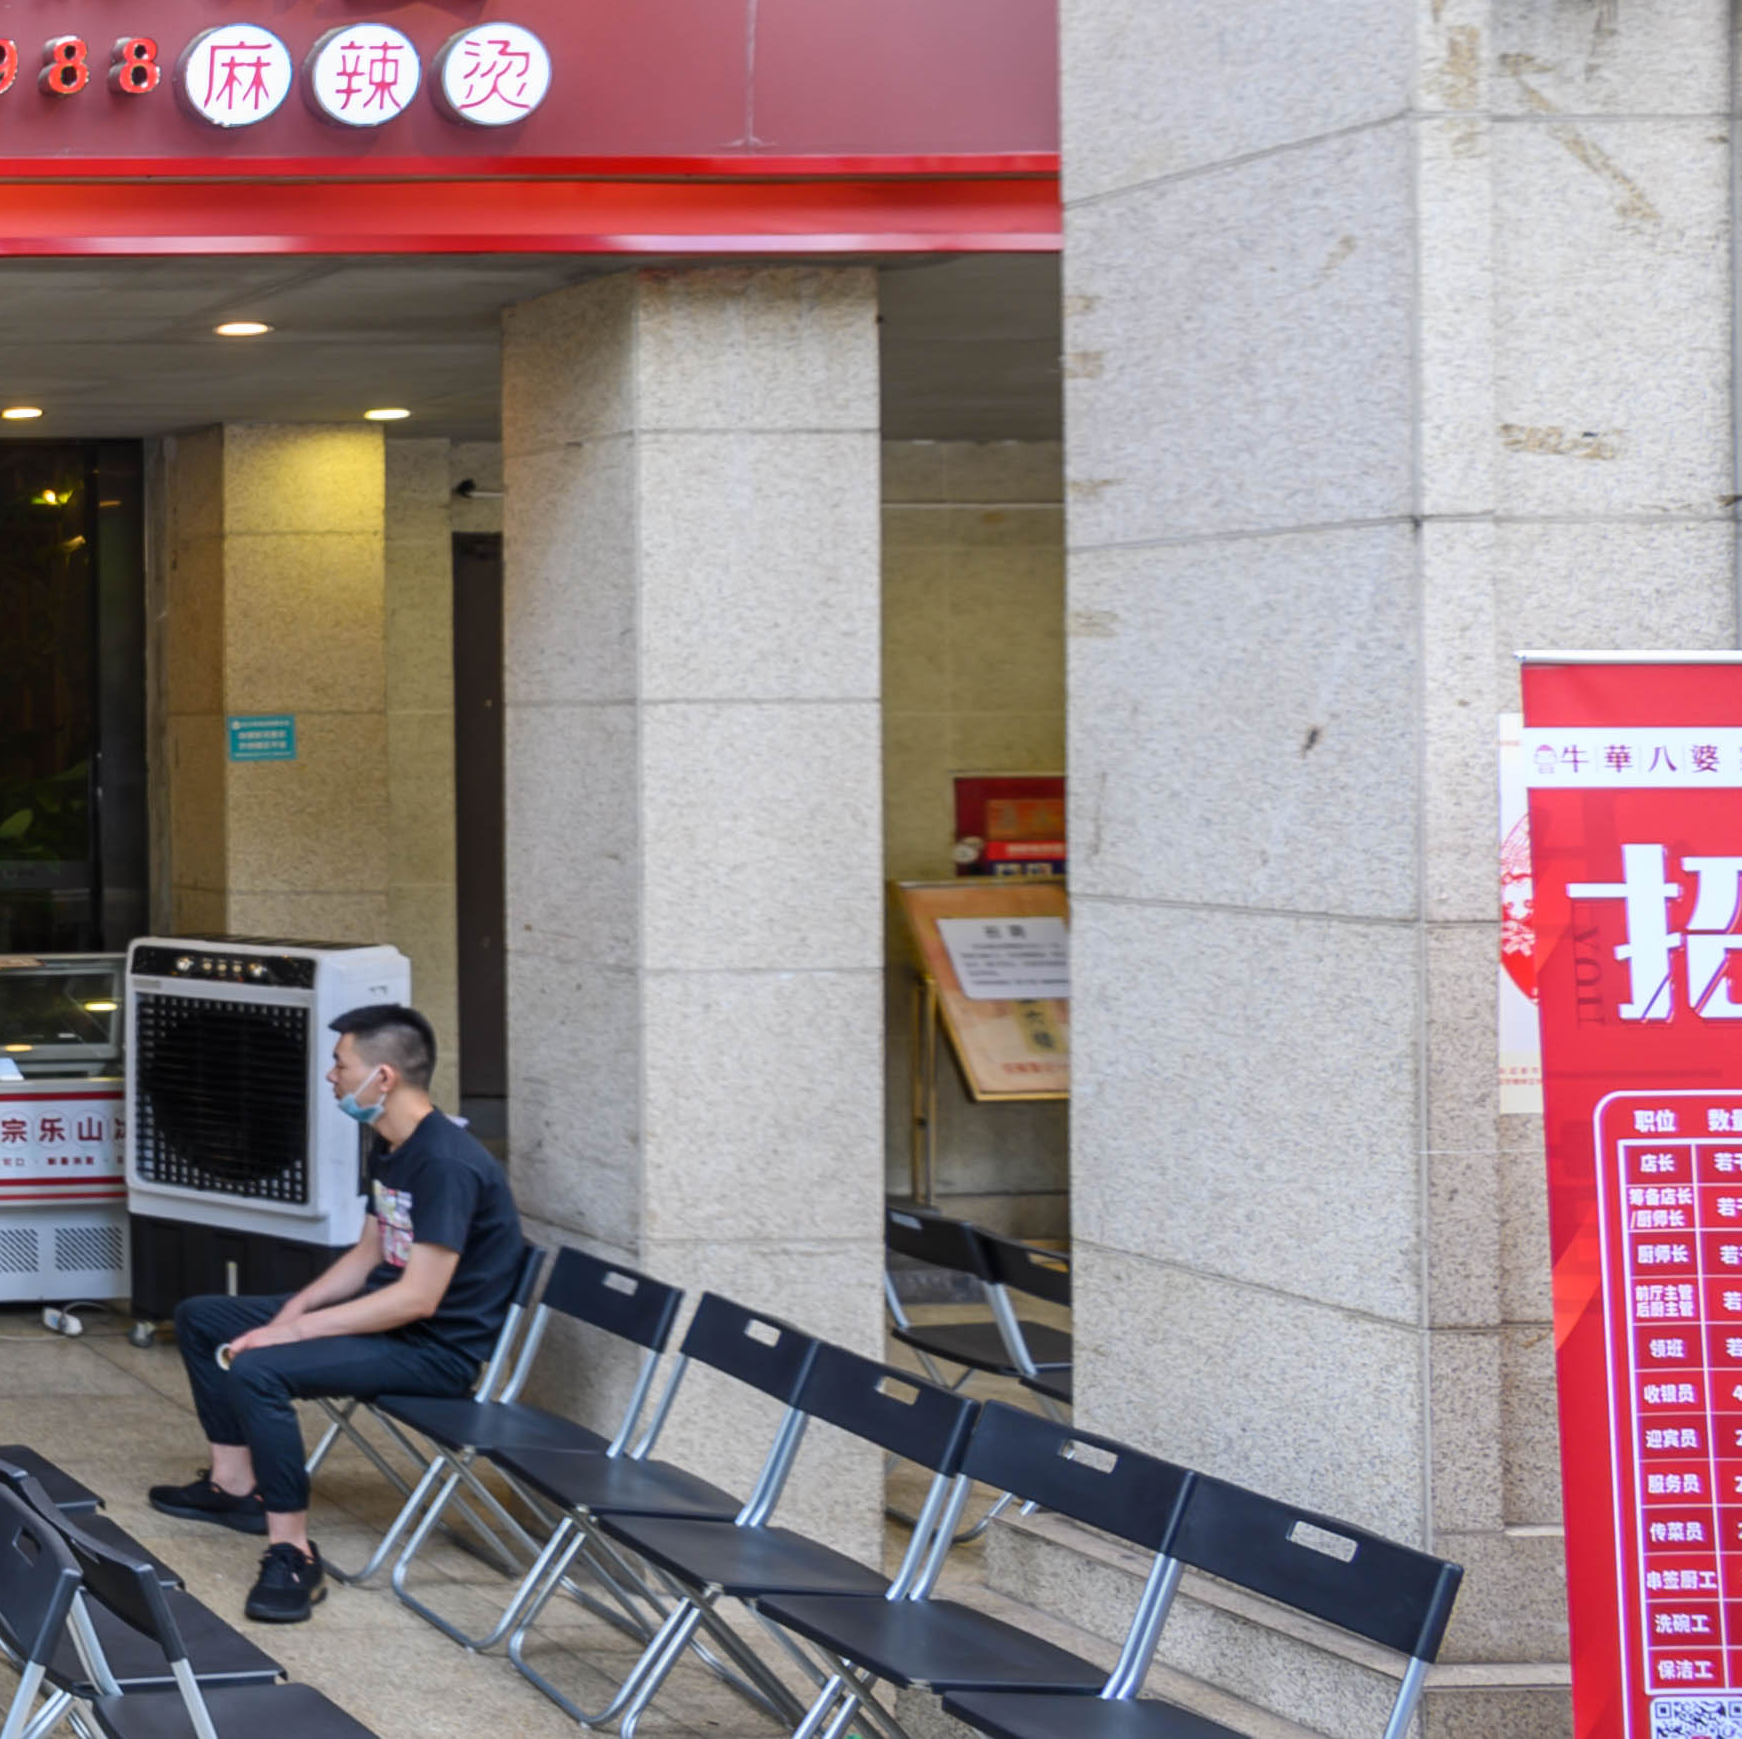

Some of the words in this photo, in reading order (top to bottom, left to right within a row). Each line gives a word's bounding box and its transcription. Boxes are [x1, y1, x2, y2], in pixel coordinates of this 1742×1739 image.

[202, 39, 530, 112] 麻辣烫
[1561, 744, 1720, 774] 牛華八婆
[1633, 1109, 1677, 1133] 职位
[1640, 1153, 1676, 1173] 店长
[1629, 1187, 1693, 1206] 筹备店长
[1637, 1244, 1689, 1264] 厨师长
[1649, 1338, 1684, 1358] 领班
[1643, 1384, 1695, 1404] 收银员
[1645, 1428, 1698, 1449] 迎宾员
[1647, 1473, 1701, 1494] 服务员
[1649, 1521, 1703, 1542] 传菜员
[1654, 1613, 1711, 1634] 洗碗工
[1657, 1659, 1714, 1680] 保洁工
